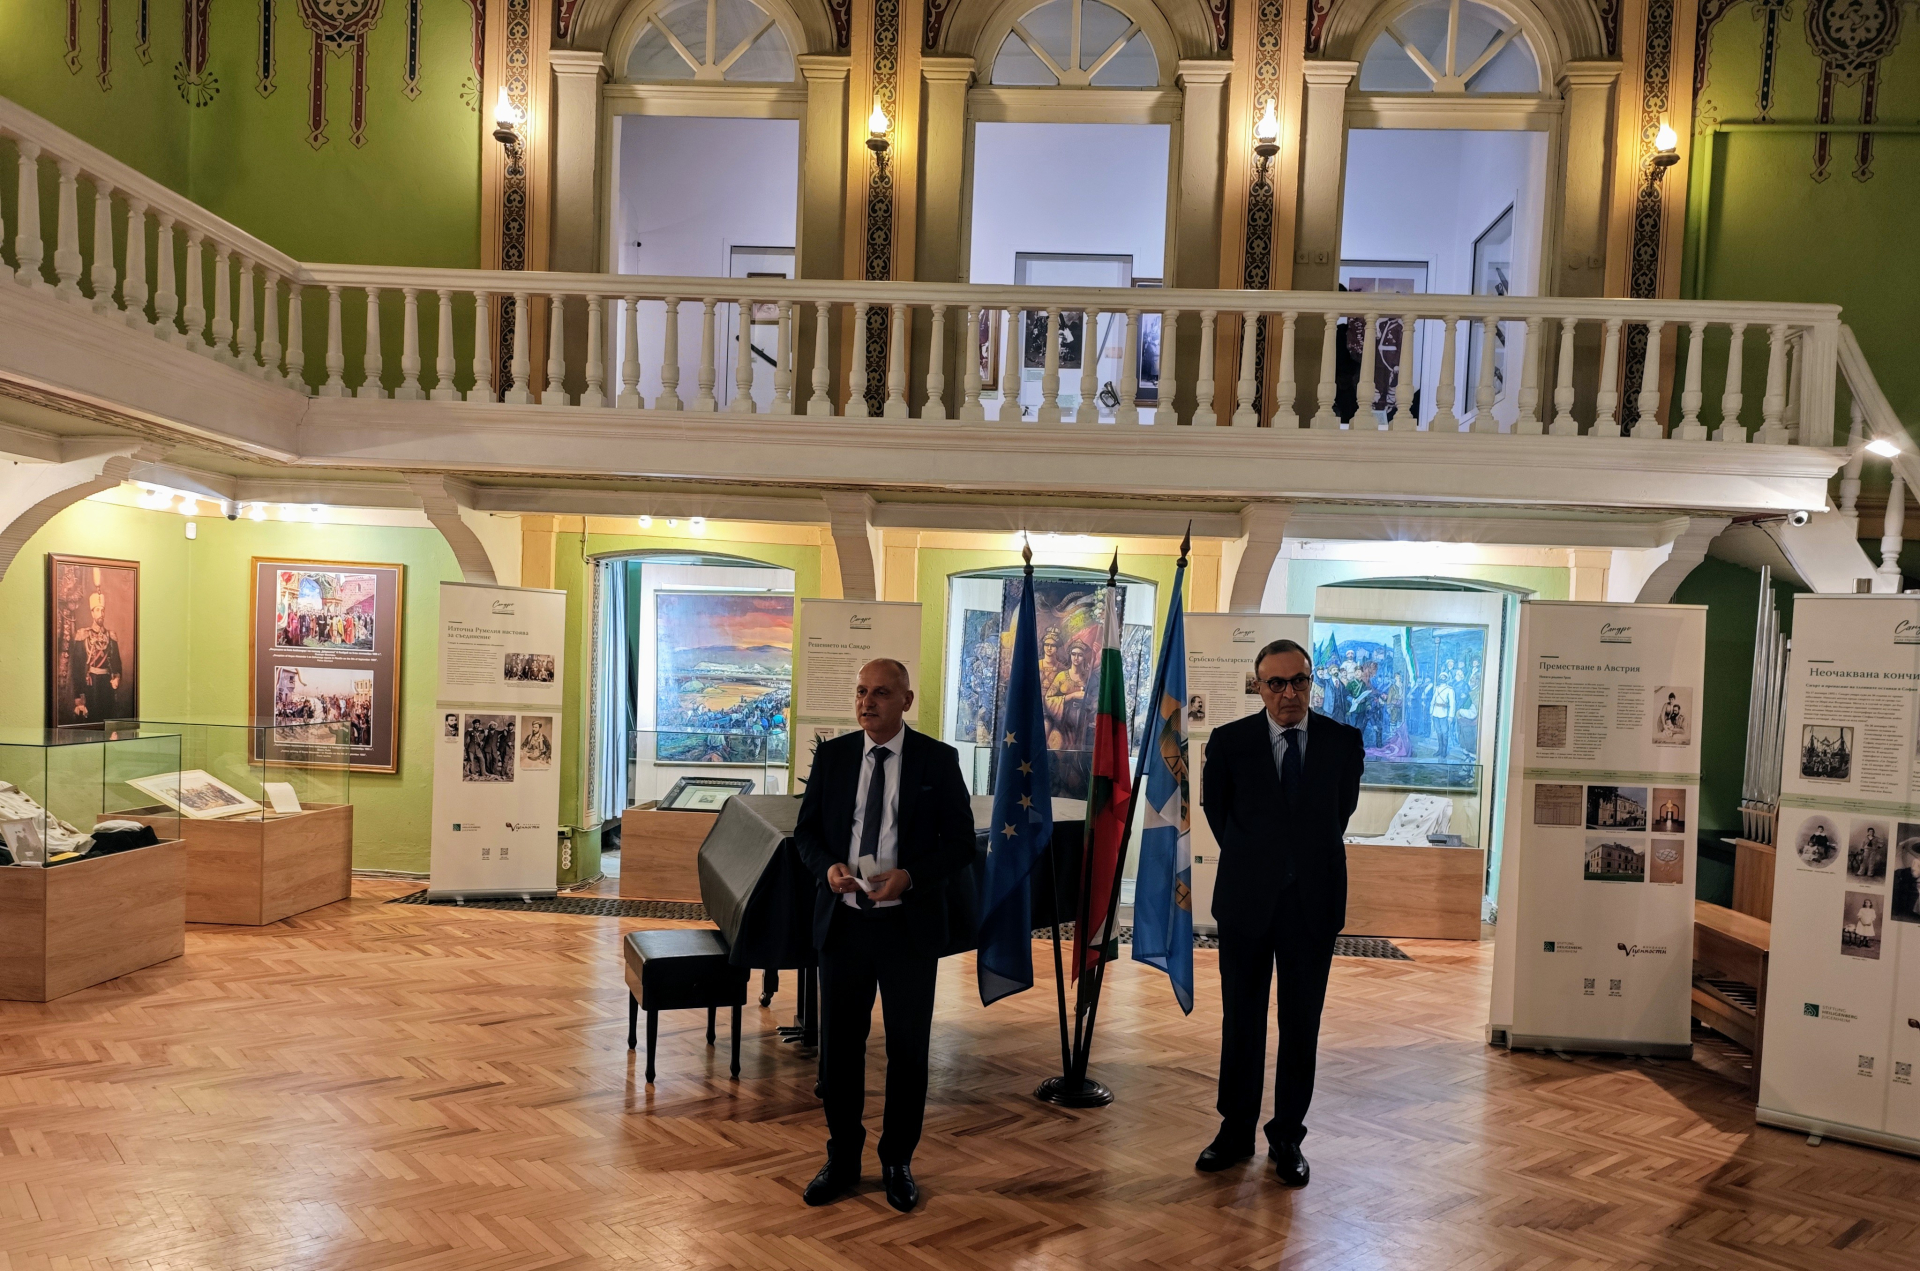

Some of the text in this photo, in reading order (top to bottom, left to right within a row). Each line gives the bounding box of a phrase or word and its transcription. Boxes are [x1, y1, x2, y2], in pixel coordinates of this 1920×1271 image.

[475, 627, 501, 635] Румелия
[1189, 656, 1254, 664] Сръбско-българската
[1539, 662, 1595, 671] Преместване
[1604, 664, 1640, 674] Австрия
[1809, 667, 1880, 679] Неочаквана
[1822, 1011, 1858, 1019] HEILIGENBERG
